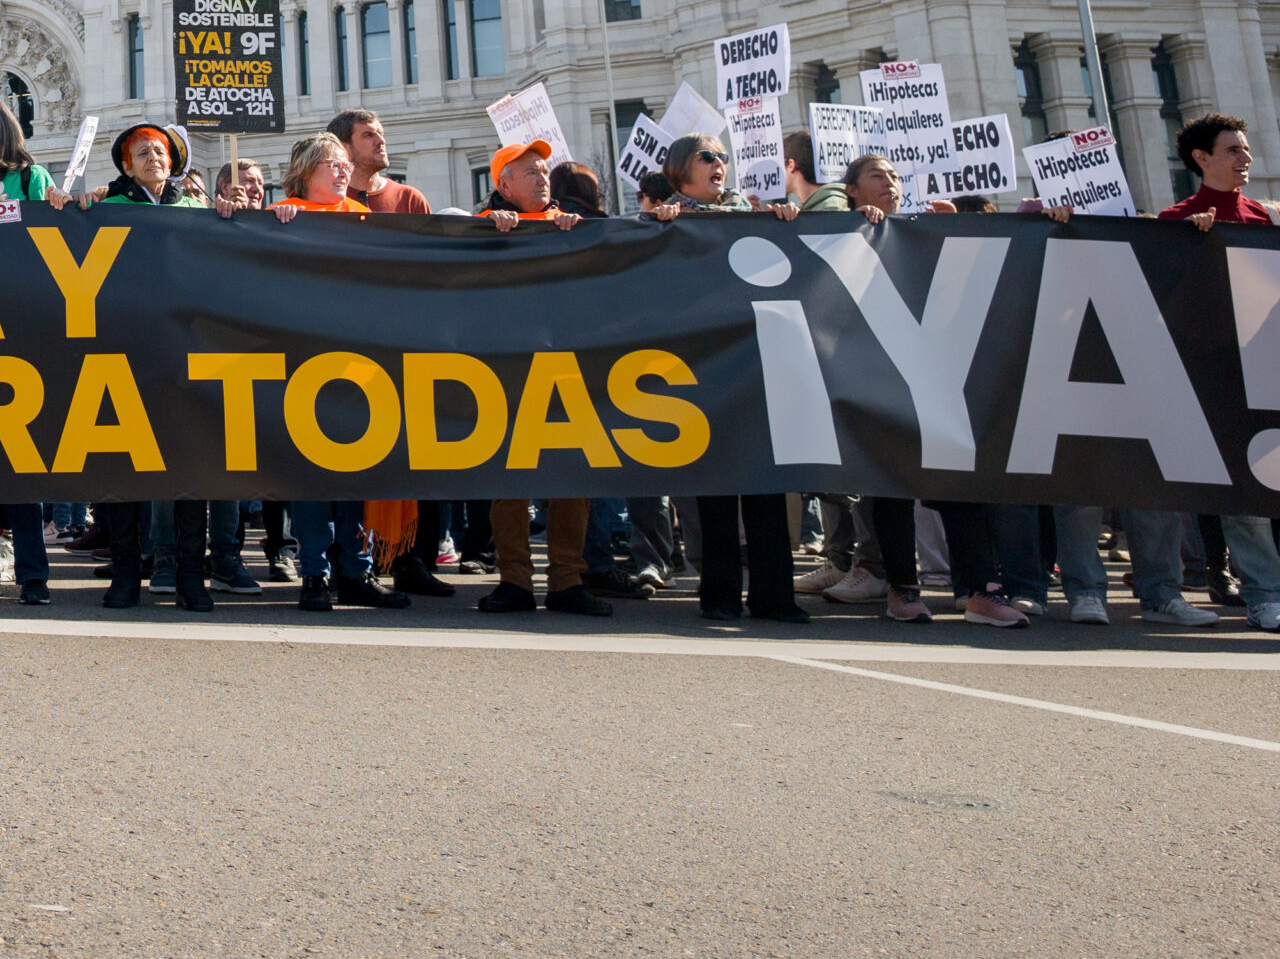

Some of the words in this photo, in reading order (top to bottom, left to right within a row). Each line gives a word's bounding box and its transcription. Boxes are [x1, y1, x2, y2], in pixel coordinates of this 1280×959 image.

[195, 0, 244, 13] DIGNA
[246, 0, 257, 13] Y
[178, 13, 274, 26] SOSTENIBLE
[179, 31, 231, 55] ¡YA!
[240, 32, 276, 55] 9F
[720, 30, 778, 66] DERECHO
[185, 60, 272, 74] ¡TOMAMOS
[884, 63, 916, 74] NO+
[190, 74, 211, 87] LA
[212, 74, 268, 88] CALLE!
[726, 78, 734, 102] A
[736, 68, 782, 99] TECHO.
[869, 81, 938, 104] ¡Hipotecas
[185, 87, 206, 100] DE
[208, 87, 274, 102] ATOCHA
[739, 98, 760, 109] NO+
[187, 102, 200, 115] A
[200, 102, 234, 115] SOL
[246, 102, 274, 116] 12H
[730, 112, 775, 136] ¡Hipotecas
[886, 109, 944, 134] alquileres
[634, 127, 658, 157] SIN
[952, 121, 1000, 152] ECHO
[1074, 128, 1108, 146] NO+
[620, 152, 634, 172] A
[818, 142, 826, 165] A
[926, 139, 950, 164] ya!
[1034, 148, 1110, 180] ¡Hipotecas
[764, 167, 780, 191] ya!
[927, 173, 940, 194] A
[942, 162, 1008, 192] TECHO.
[1060, 180, 1122, 210] alquileres
[27, 226, 131, 338] Y
[187, 349, 711, 473] TODAS
